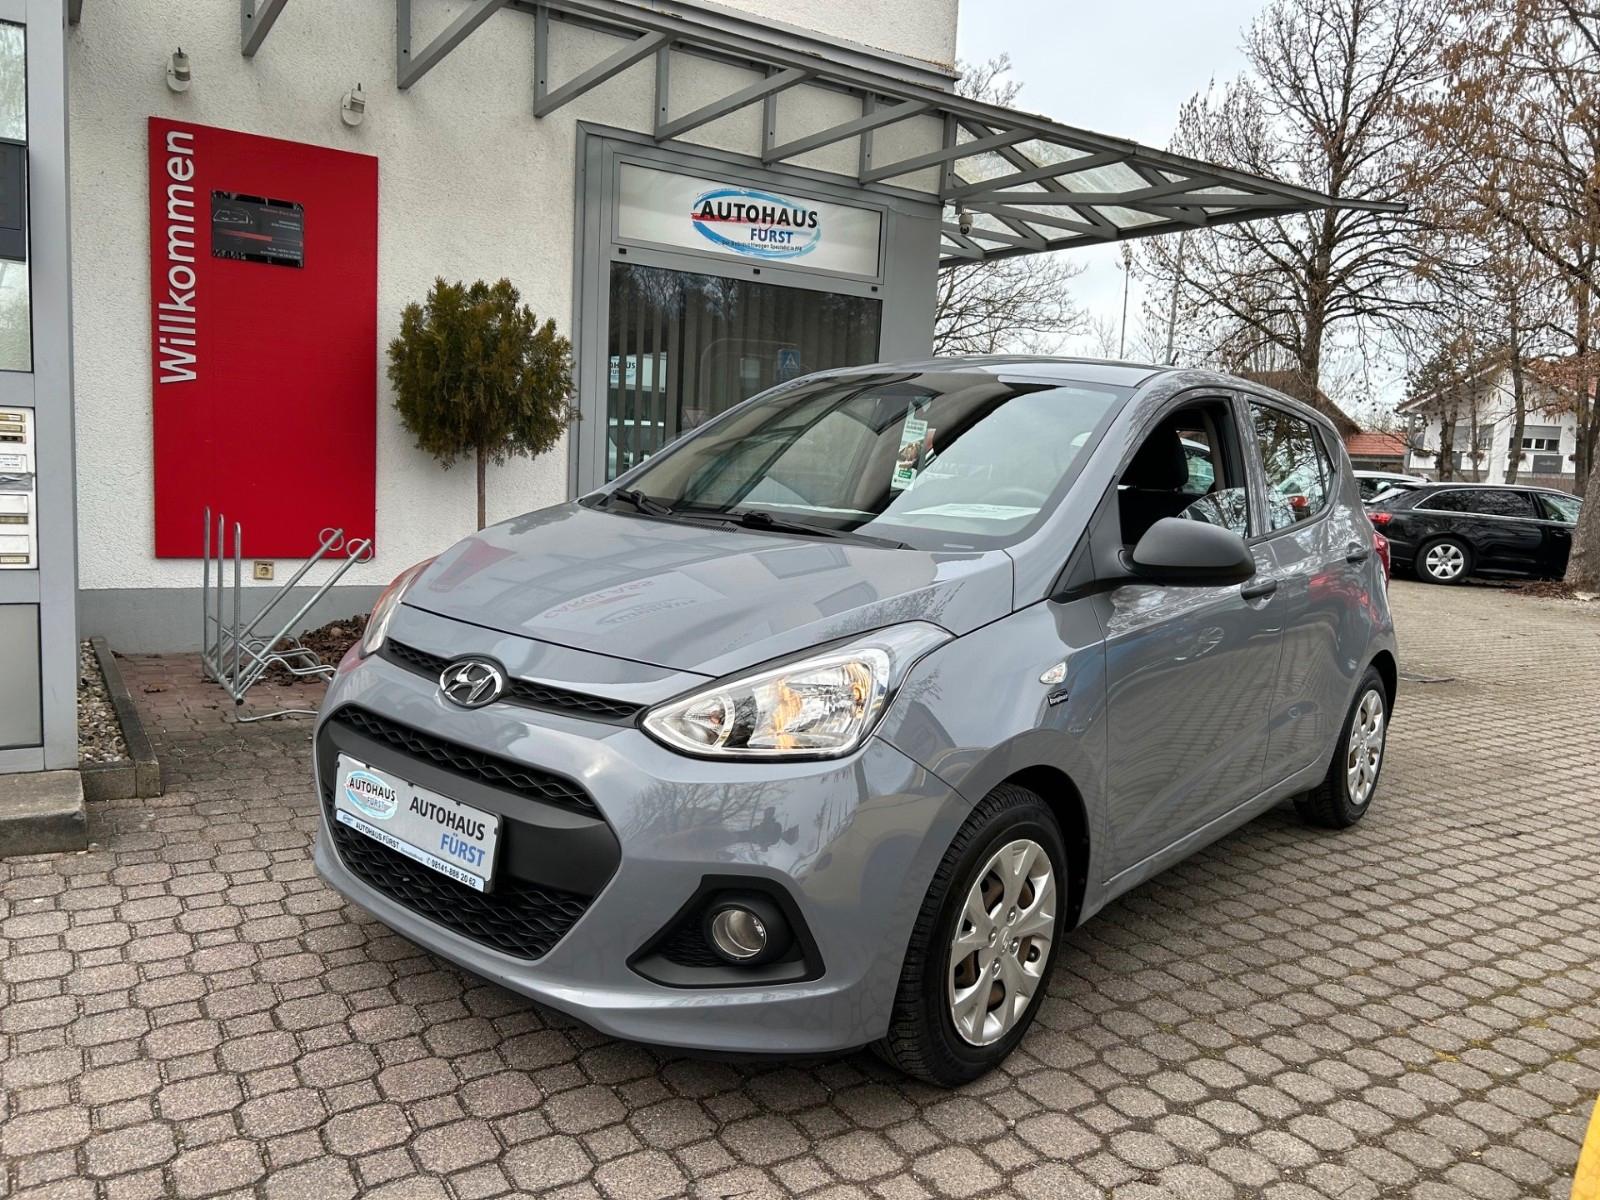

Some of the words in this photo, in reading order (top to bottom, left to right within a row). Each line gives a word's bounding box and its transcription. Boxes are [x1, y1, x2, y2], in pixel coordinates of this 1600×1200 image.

[700, 201, 818, 228] AUTOHAUS
[158, 130, 197, 384] Willkommen
[349, 778, 396, 802] AUTOHAUS
[409, 797, 486, 841] AUTOHAUS
[356, 823, 383, 842] AUTOHAUS
[382, 835, 400, 850] FÜRST
[440, 832, 486, 867] FÜRST
